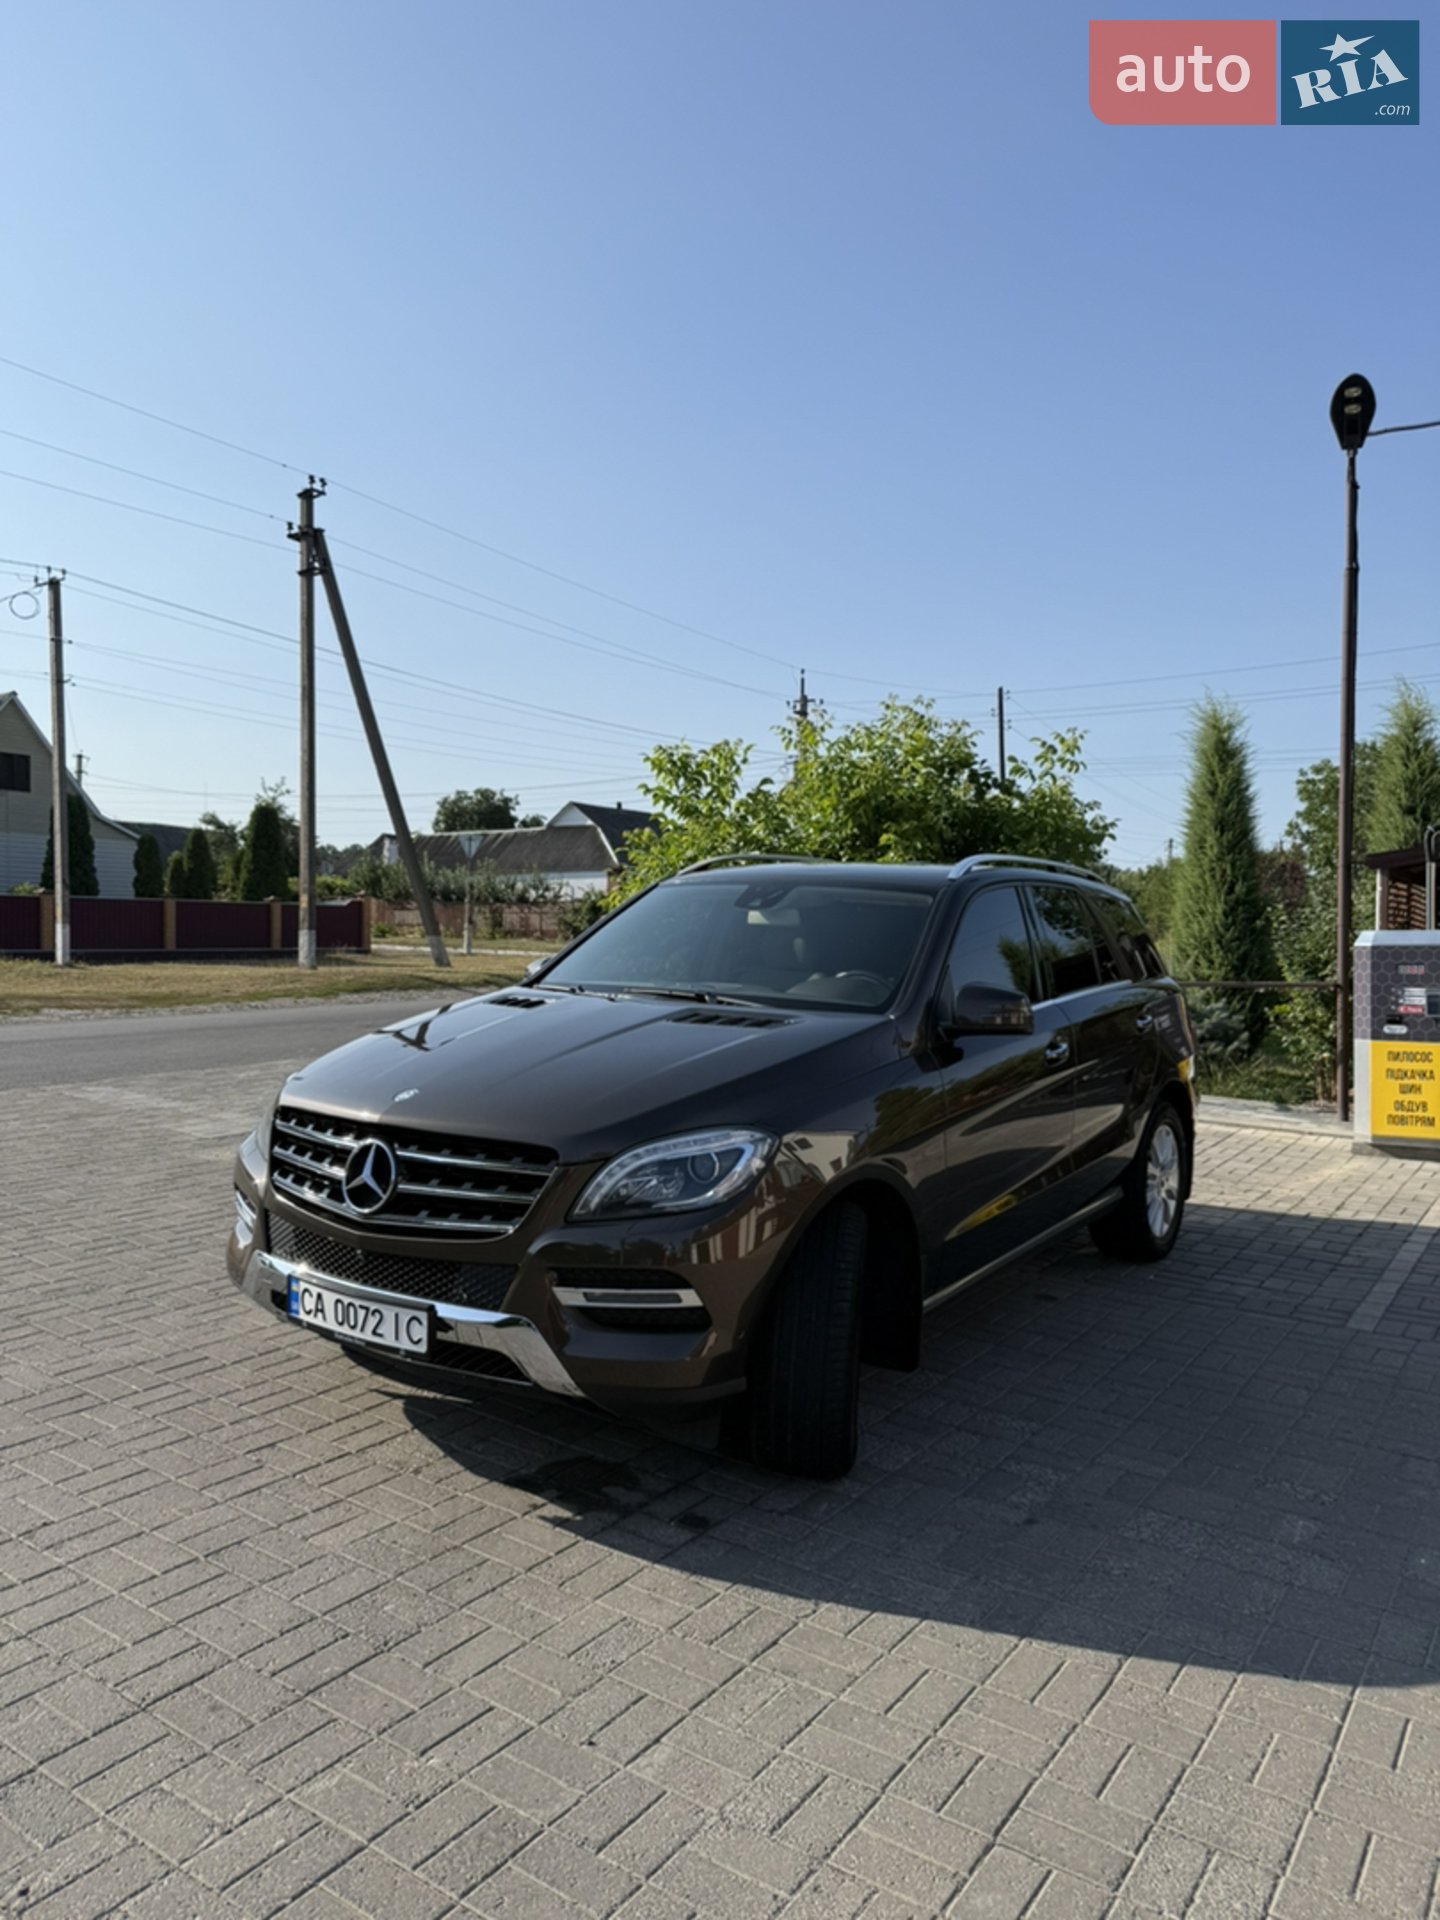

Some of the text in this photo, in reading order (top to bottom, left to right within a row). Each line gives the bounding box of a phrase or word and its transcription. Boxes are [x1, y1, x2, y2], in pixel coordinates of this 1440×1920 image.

[1386, 1050, 1434, 1063] ПИЛОСОС
[1386, 1068, 1435, 1081] ПІДКАЧКА
[1398, 1083, 1422, 1095] ШИН
[1393, 1100, 1428, 1113] ОБДУВ
[1386, 1114, 1436, 1128] ПОВІТРЯМ
[300, 1288, 327, 1322] CA
[334, 1298, 384, 1338] 0072
[394, 1312, 424, 1346] IC
